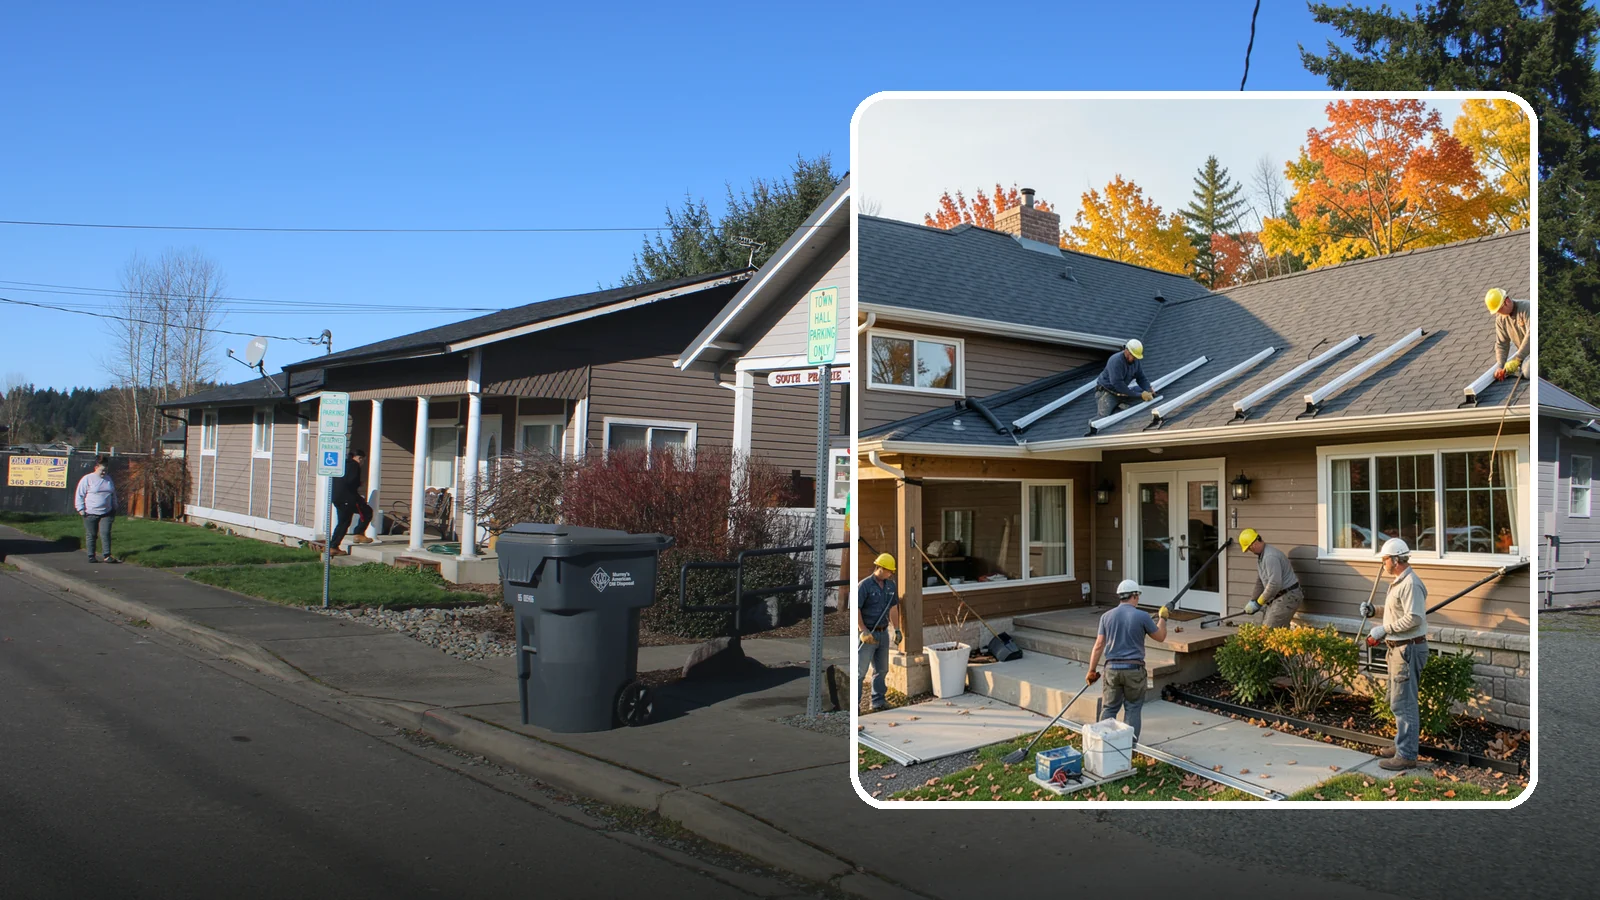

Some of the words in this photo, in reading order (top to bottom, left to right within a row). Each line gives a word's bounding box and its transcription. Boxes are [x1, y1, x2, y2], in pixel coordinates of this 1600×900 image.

[815, 295, 832, 308] TOWN
[815, 312, 831, 324] HALL
[810, 327, 835, 341] PARKING
[814, 344, 830, 357] ONLY
[775, 373, 801, 384] SOUTH
[808, 371, 842, 382] PRIE
